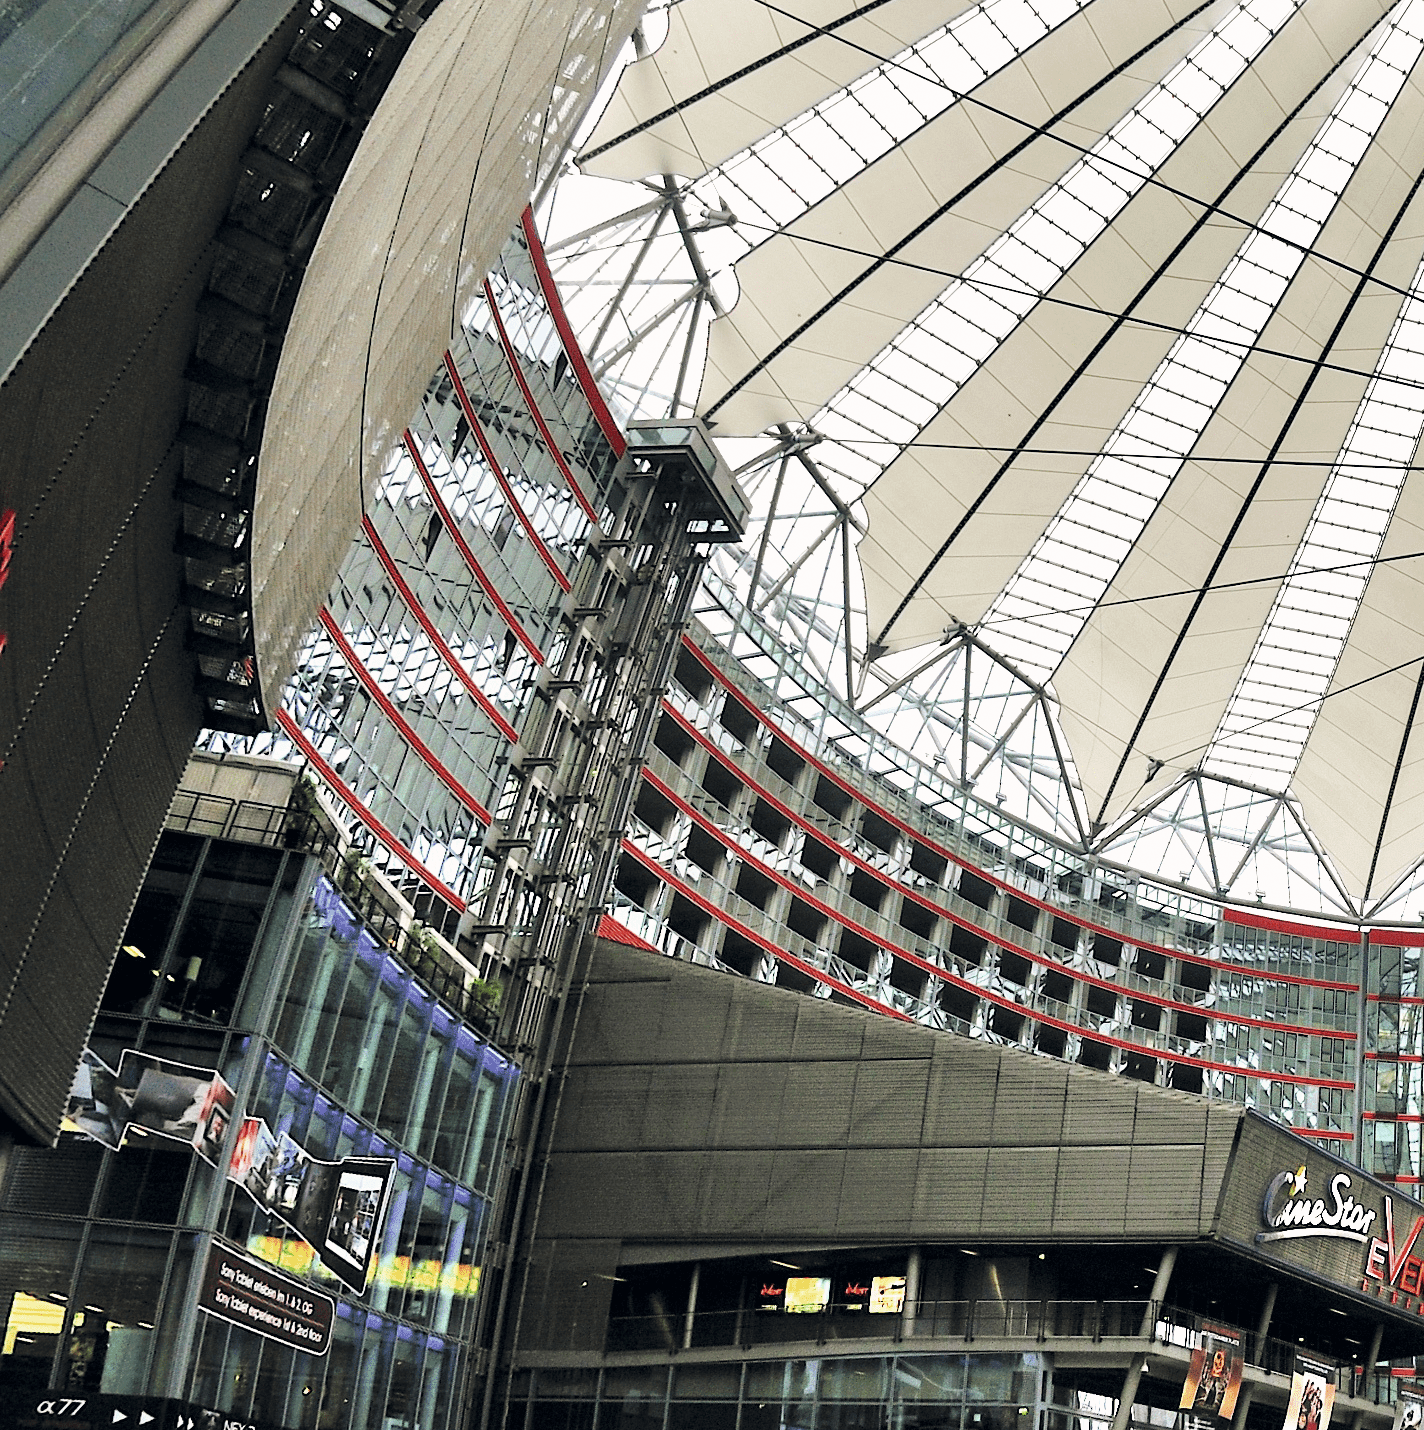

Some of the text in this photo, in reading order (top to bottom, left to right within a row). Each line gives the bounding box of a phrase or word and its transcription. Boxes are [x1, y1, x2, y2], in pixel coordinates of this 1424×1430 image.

[1263, 1168, 1377, 1234] CineStar
[215, 1288, 229, 1309] Sony
[231, 1295, 249, 1314] Tablet
[296, 1324, 308, 1338] 2nd
[308, 1329, 322, 1343] floor
[220, 1262, 235, 1282] Sony
[236, 1270, 254, 1289] Tablet
[254, 1281, 276, 1299] erleben
[302, 1301, 313, 1315] OG
